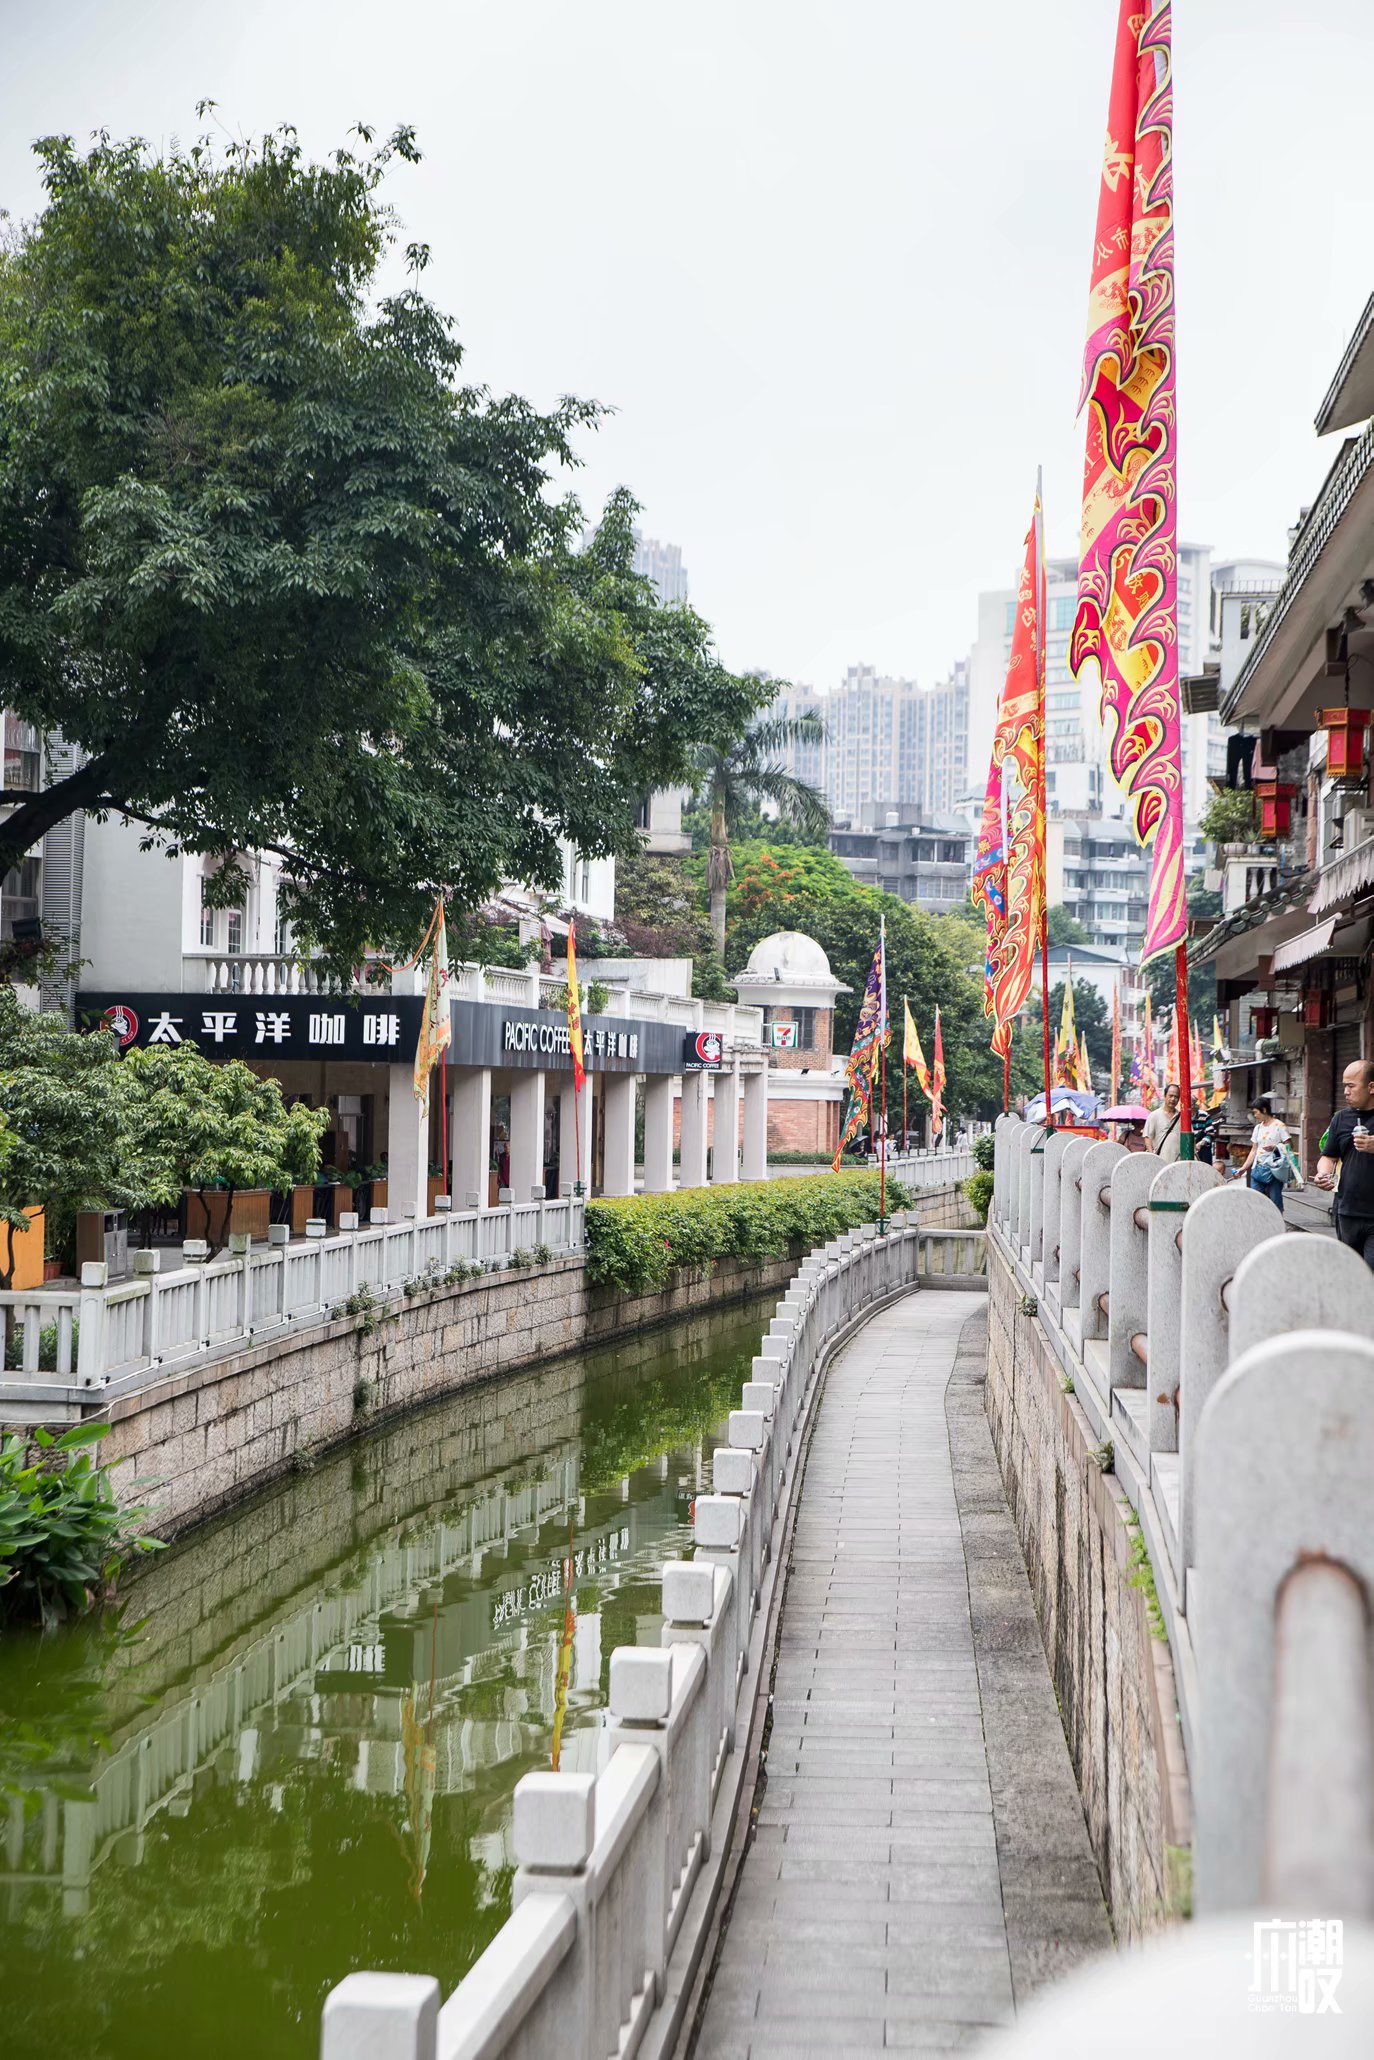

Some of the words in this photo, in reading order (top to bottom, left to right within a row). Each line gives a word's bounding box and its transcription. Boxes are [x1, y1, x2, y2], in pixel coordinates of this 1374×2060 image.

[148, 1011, 400, 1046] 太平洋咖啡
[505, 1021, 538, 1052] PACIFIC
[583, 1029, 638, 1059] 太平洋咖啡
